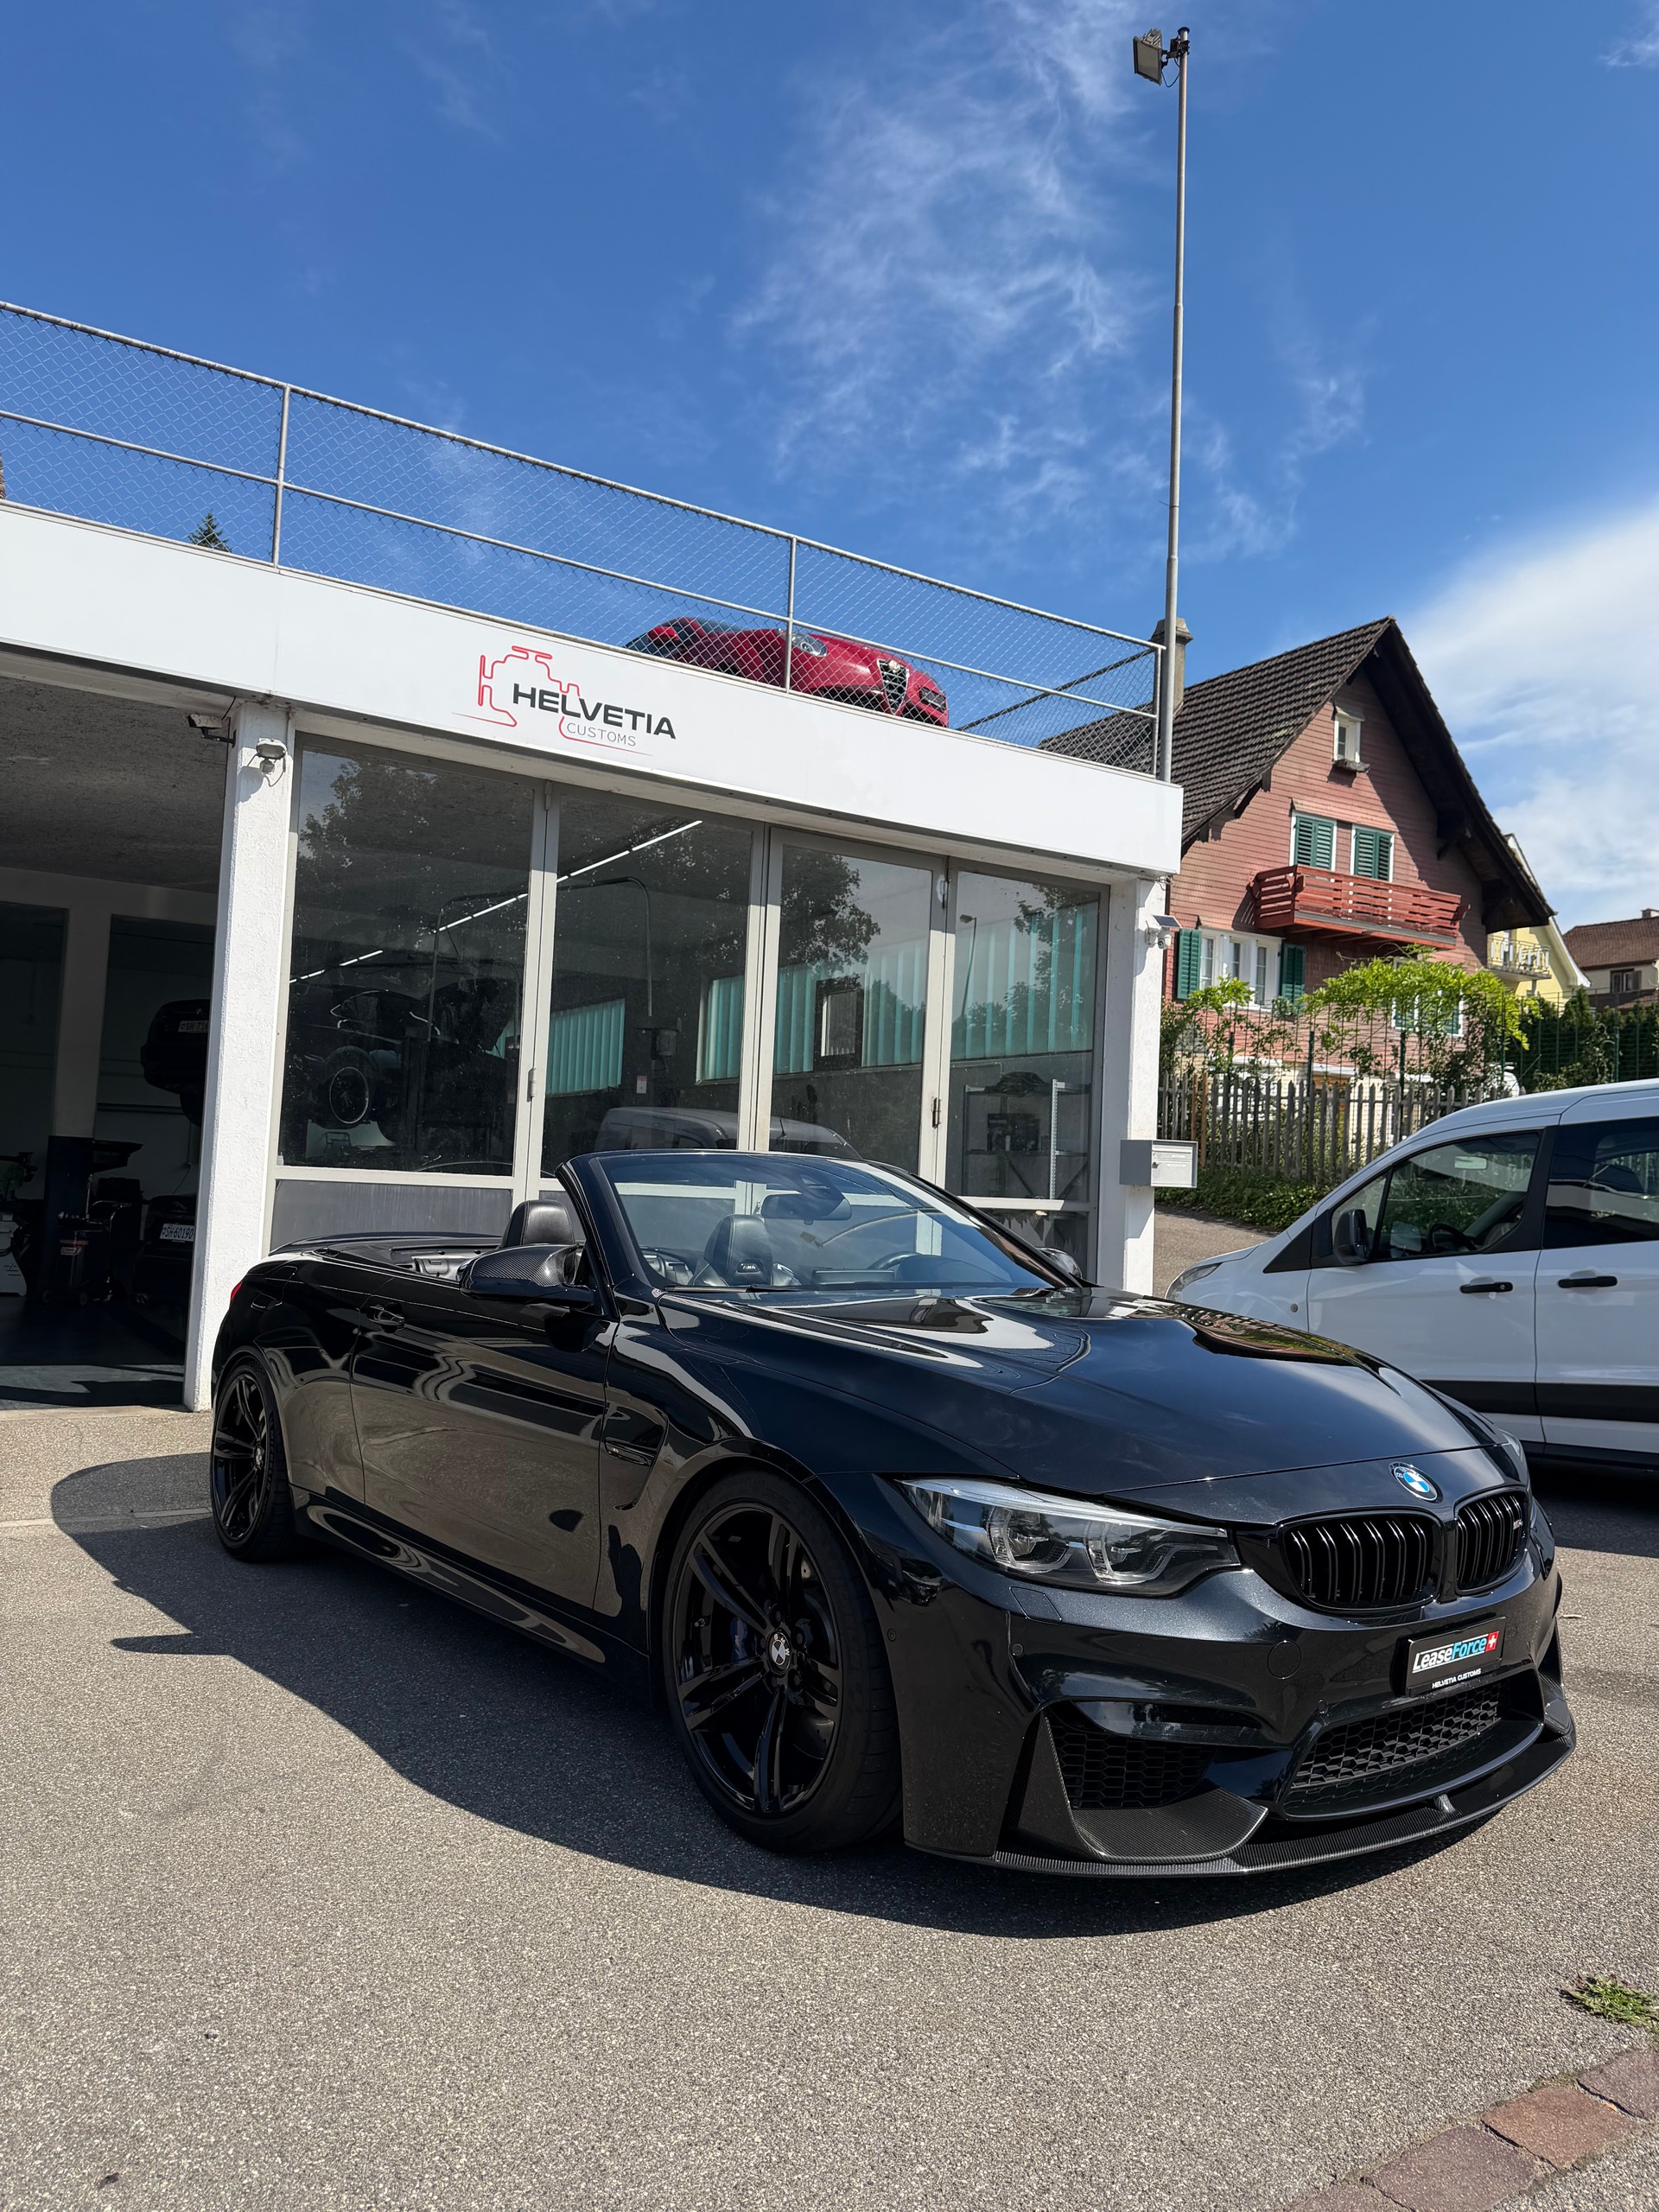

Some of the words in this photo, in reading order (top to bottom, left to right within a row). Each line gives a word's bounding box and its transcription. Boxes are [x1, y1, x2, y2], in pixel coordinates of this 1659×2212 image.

[512, 683, 677, 740] HELVETIA
[567, 722, 637, 747] CUSTOMS
[773, 1633, 790, 1656] BMW
[1413, 1637, 1487, 1671] LeaseForce
[1432, 1676, 1457, 1689] HELVETIA
[1457, 1668, 1482, 1681] CUSTOMS
